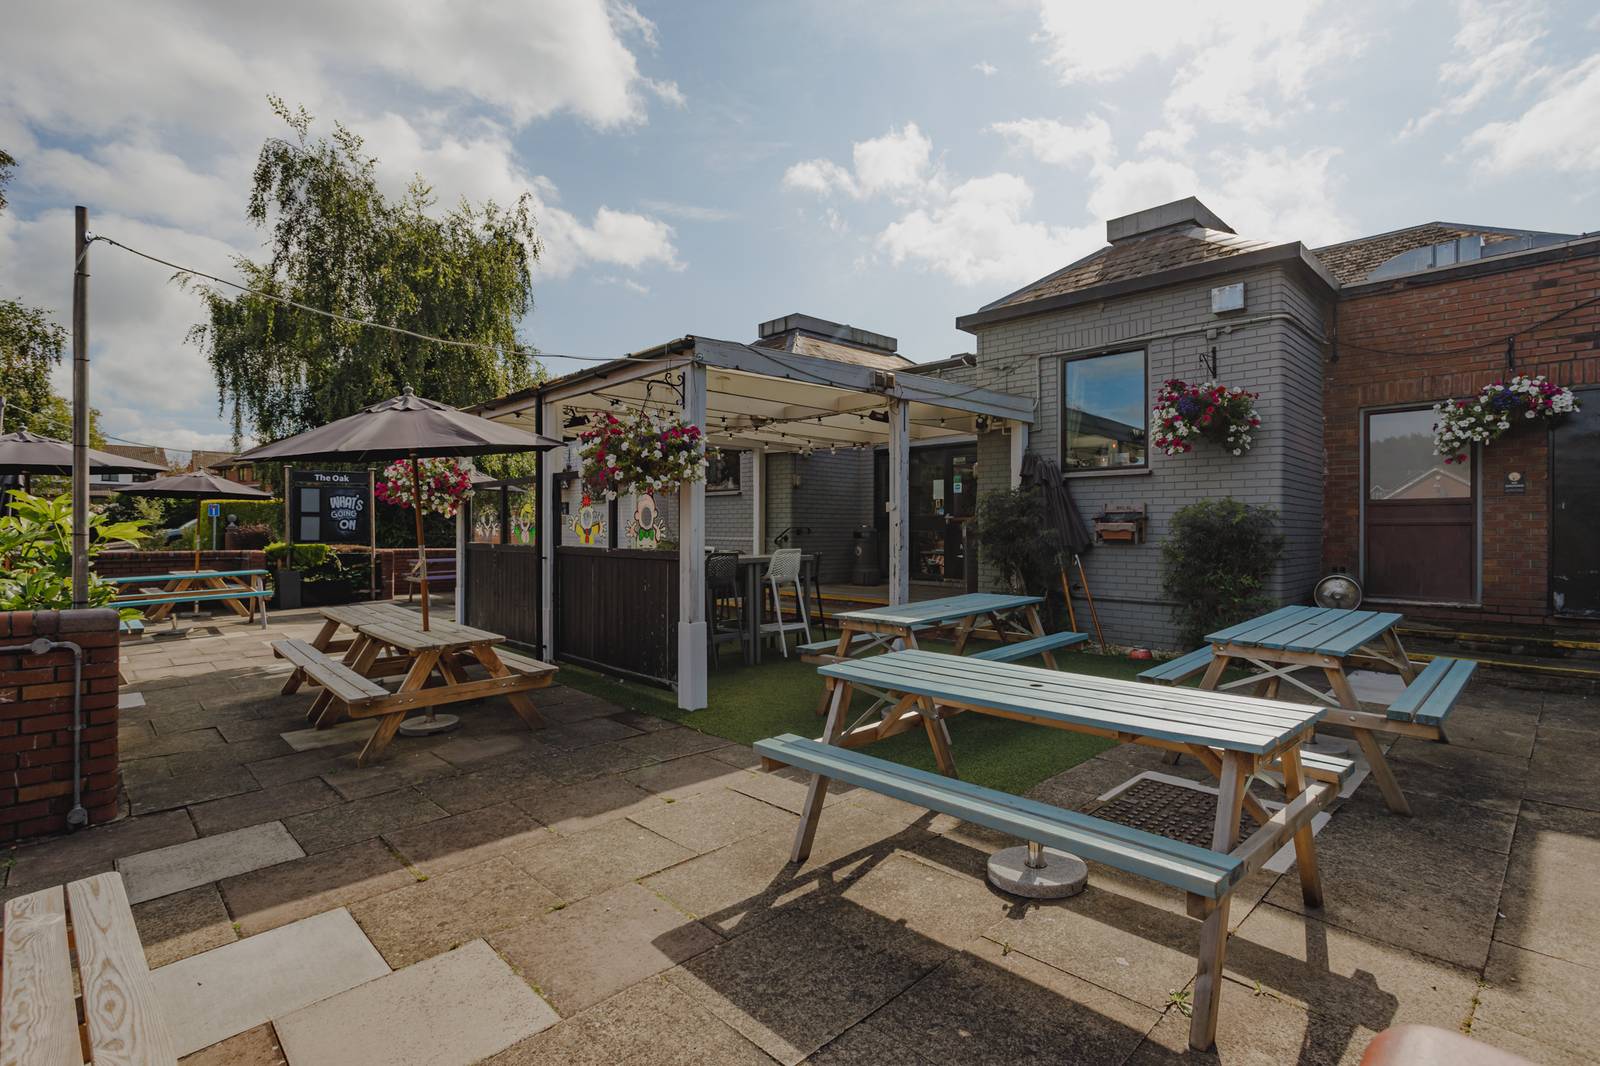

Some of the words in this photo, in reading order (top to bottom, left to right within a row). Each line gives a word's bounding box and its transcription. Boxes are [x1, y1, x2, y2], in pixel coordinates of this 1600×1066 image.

[314, 474, 331, 482] The
[330, 495, 364, 511] WHAT'S
[331, 510, 357, 518] GOING
[340, 520, 357, 531] ON
